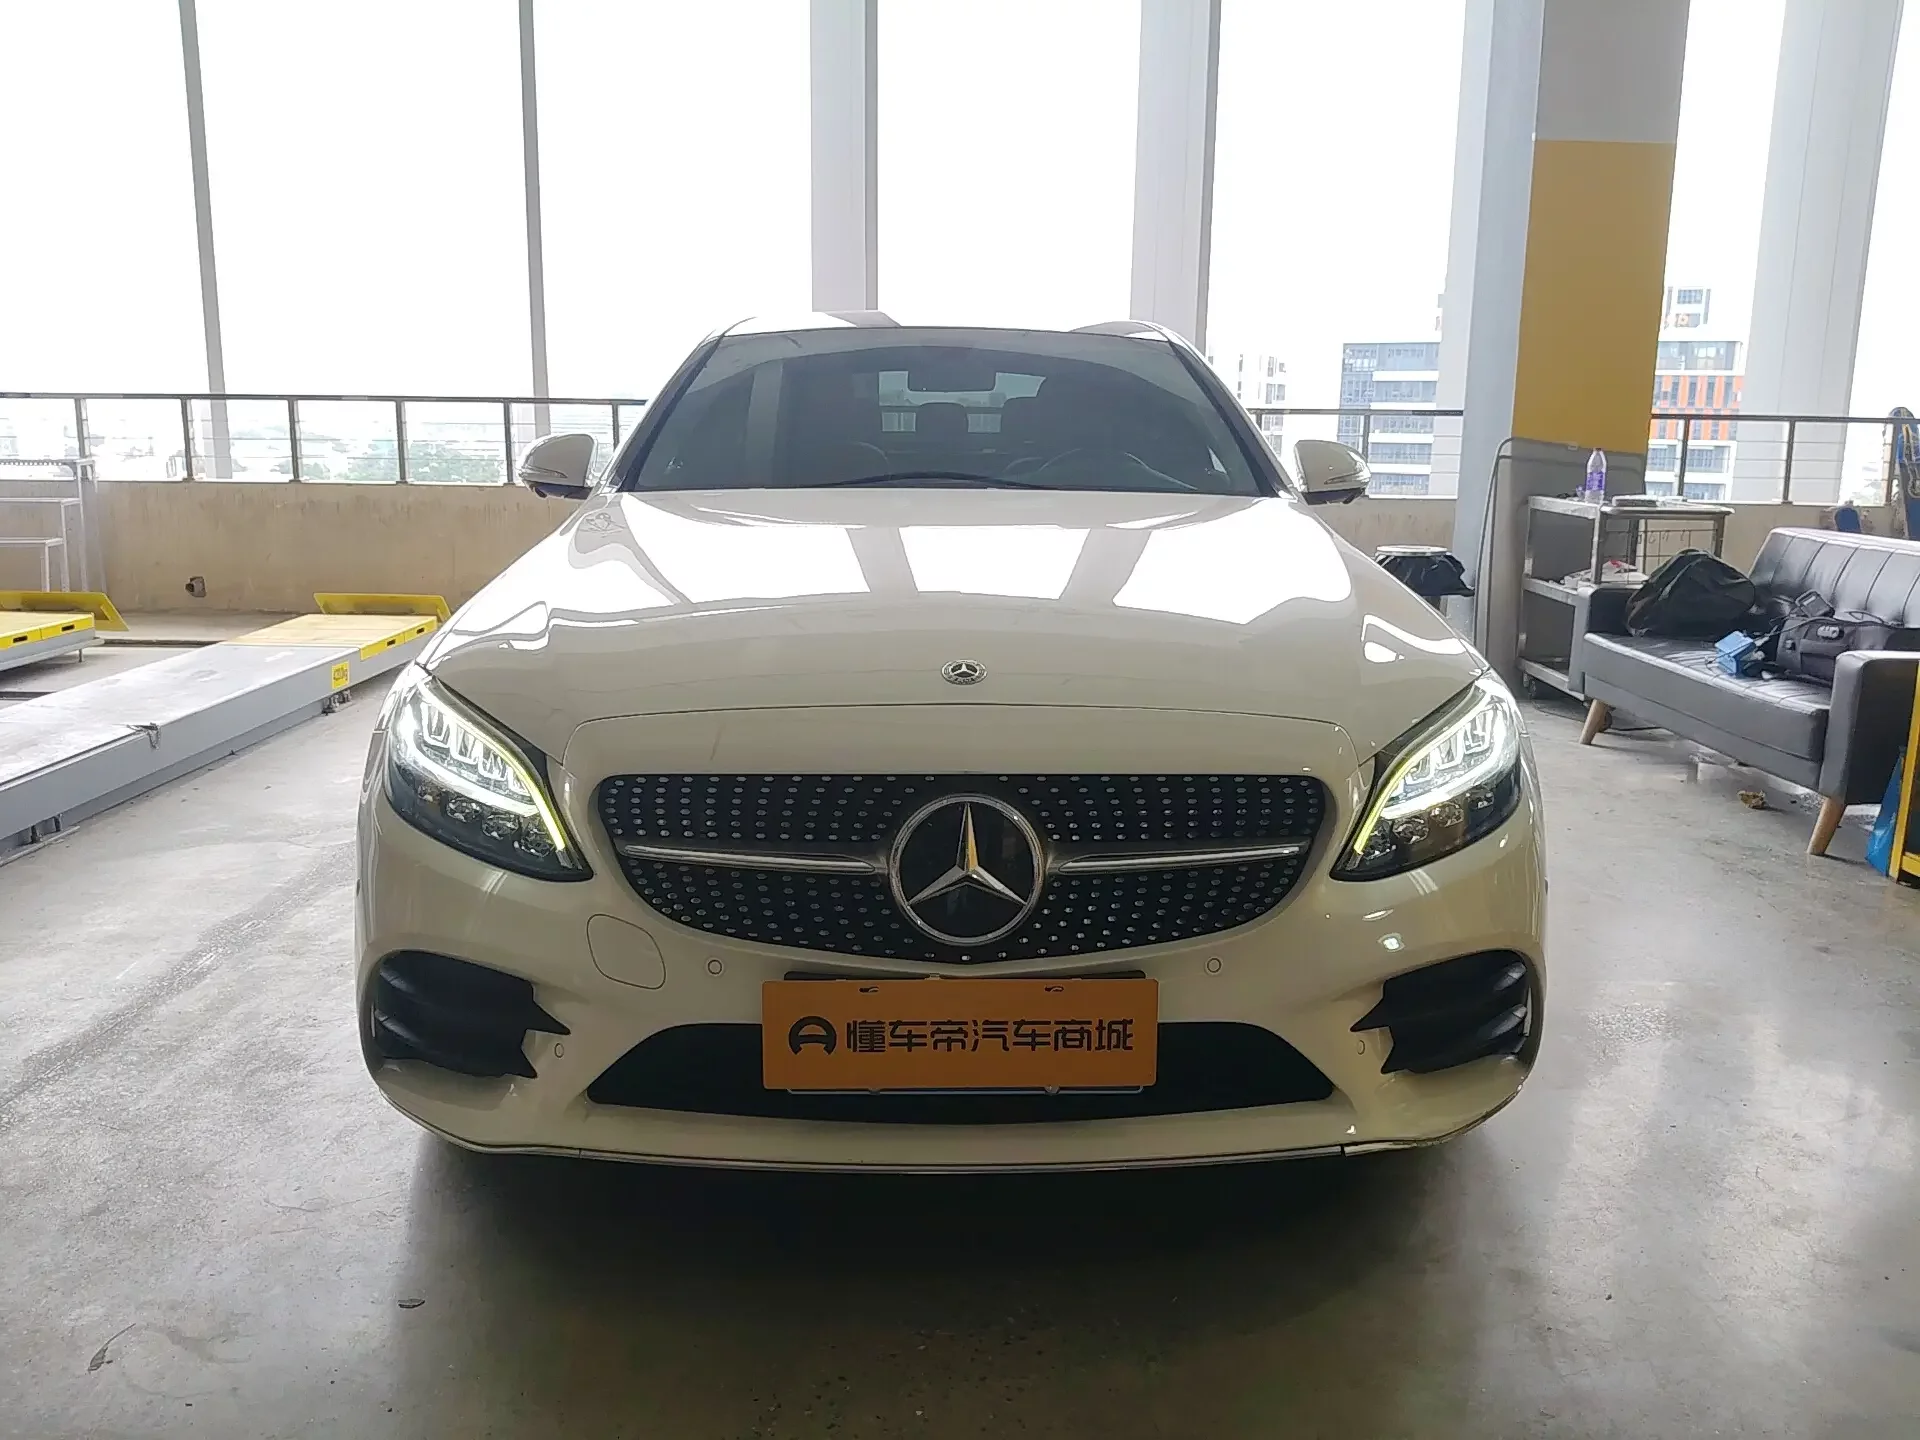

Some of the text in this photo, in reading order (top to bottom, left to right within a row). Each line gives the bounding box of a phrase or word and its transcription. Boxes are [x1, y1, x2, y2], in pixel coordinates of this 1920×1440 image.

[846, 1018, 1134, 1053] 懂车帝汽车商城
